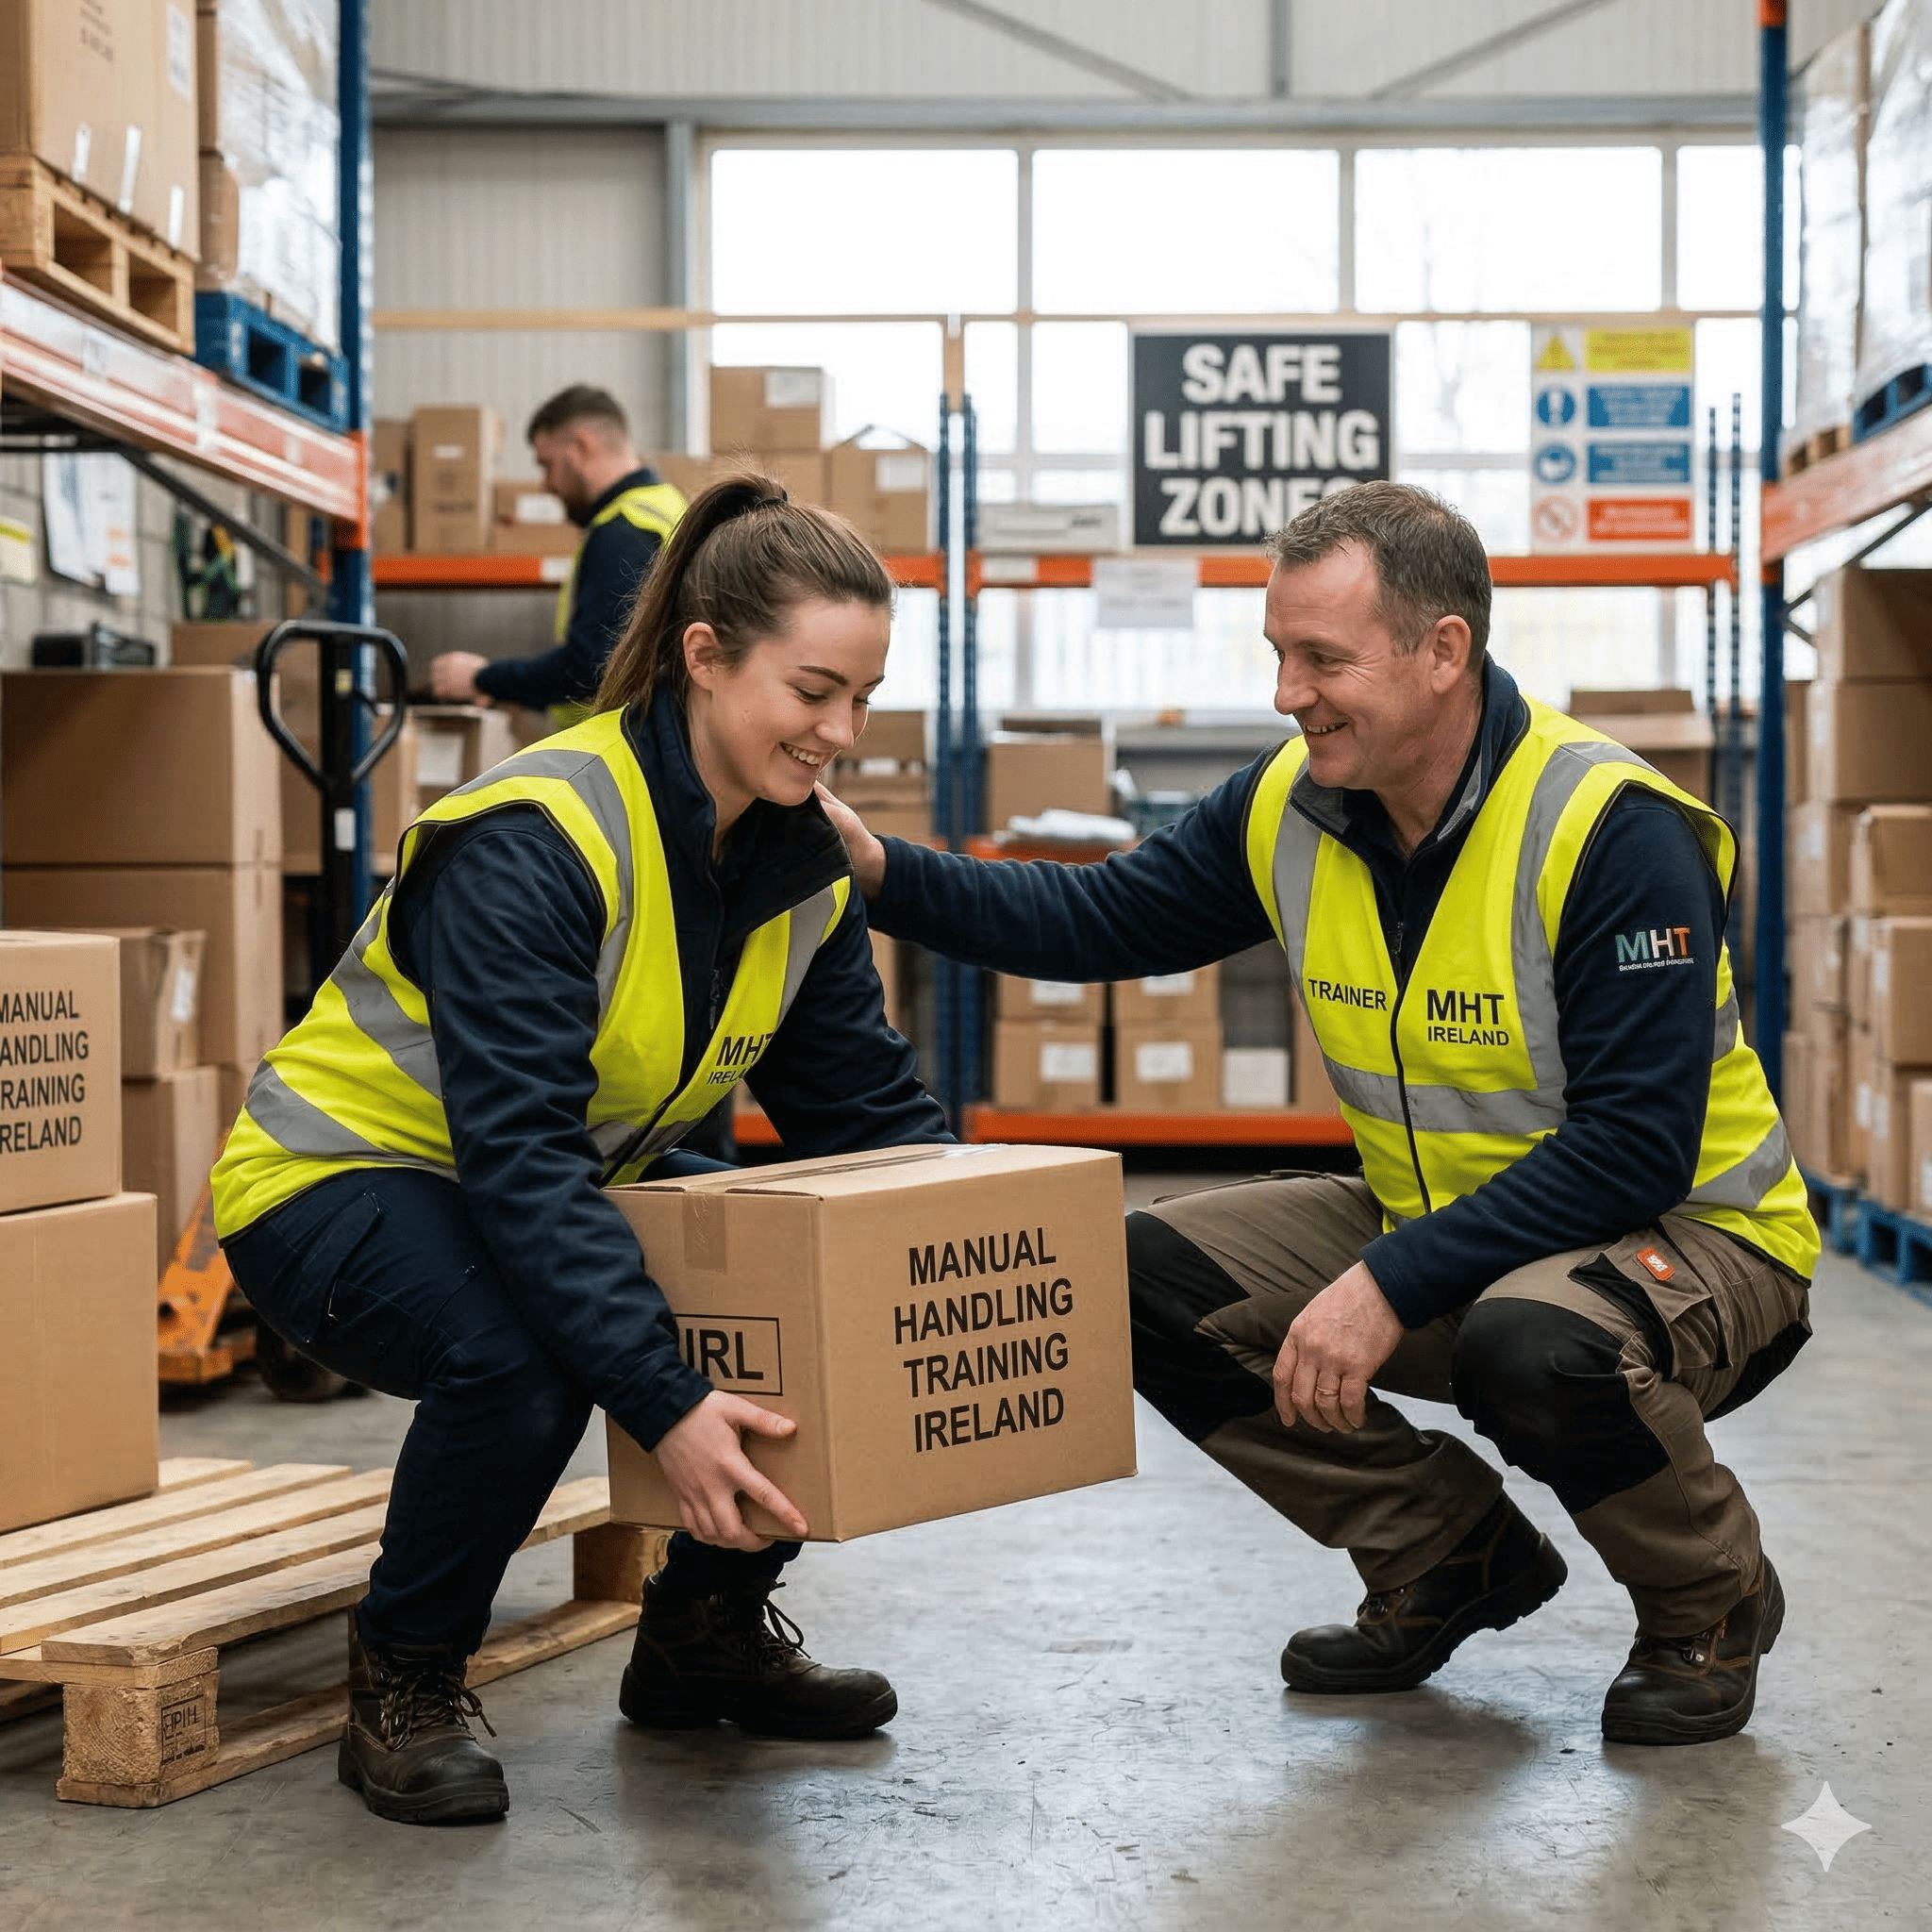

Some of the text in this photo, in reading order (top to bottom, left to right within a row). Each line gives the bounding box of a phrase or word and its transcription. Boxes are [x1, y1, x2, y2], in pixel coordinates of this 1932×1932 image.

[1182, 343, 1342, 405] SAFE
[1144, 409, 1380, 471] LIFTING
[1158, 476, 1359, 537] ZONE
[1615, 927, 1690, 963] MHT
[1307, 978, 1388, 1011] TRAINER
[1426, 989, 1505, 1025] MHT
[0, 1030, 90, 1067] ANDLING
[1427, 1025, 1510, 1046] IRELAND
[1, 1073, 86, 1110] RAINING
[706, 1068, 746, 1085] IREL
[0, 1116, 82, 1155] RELAND
[908, 1227, 1056, 1286] MANUAL
[894, 1278, 1073, 1344] HANDLING
[686, 1328, 763, 1380] IRL
[904, 1332, 1069, 1398] TRAINING
[914, 1388, 1064, 1453] IRELAND
